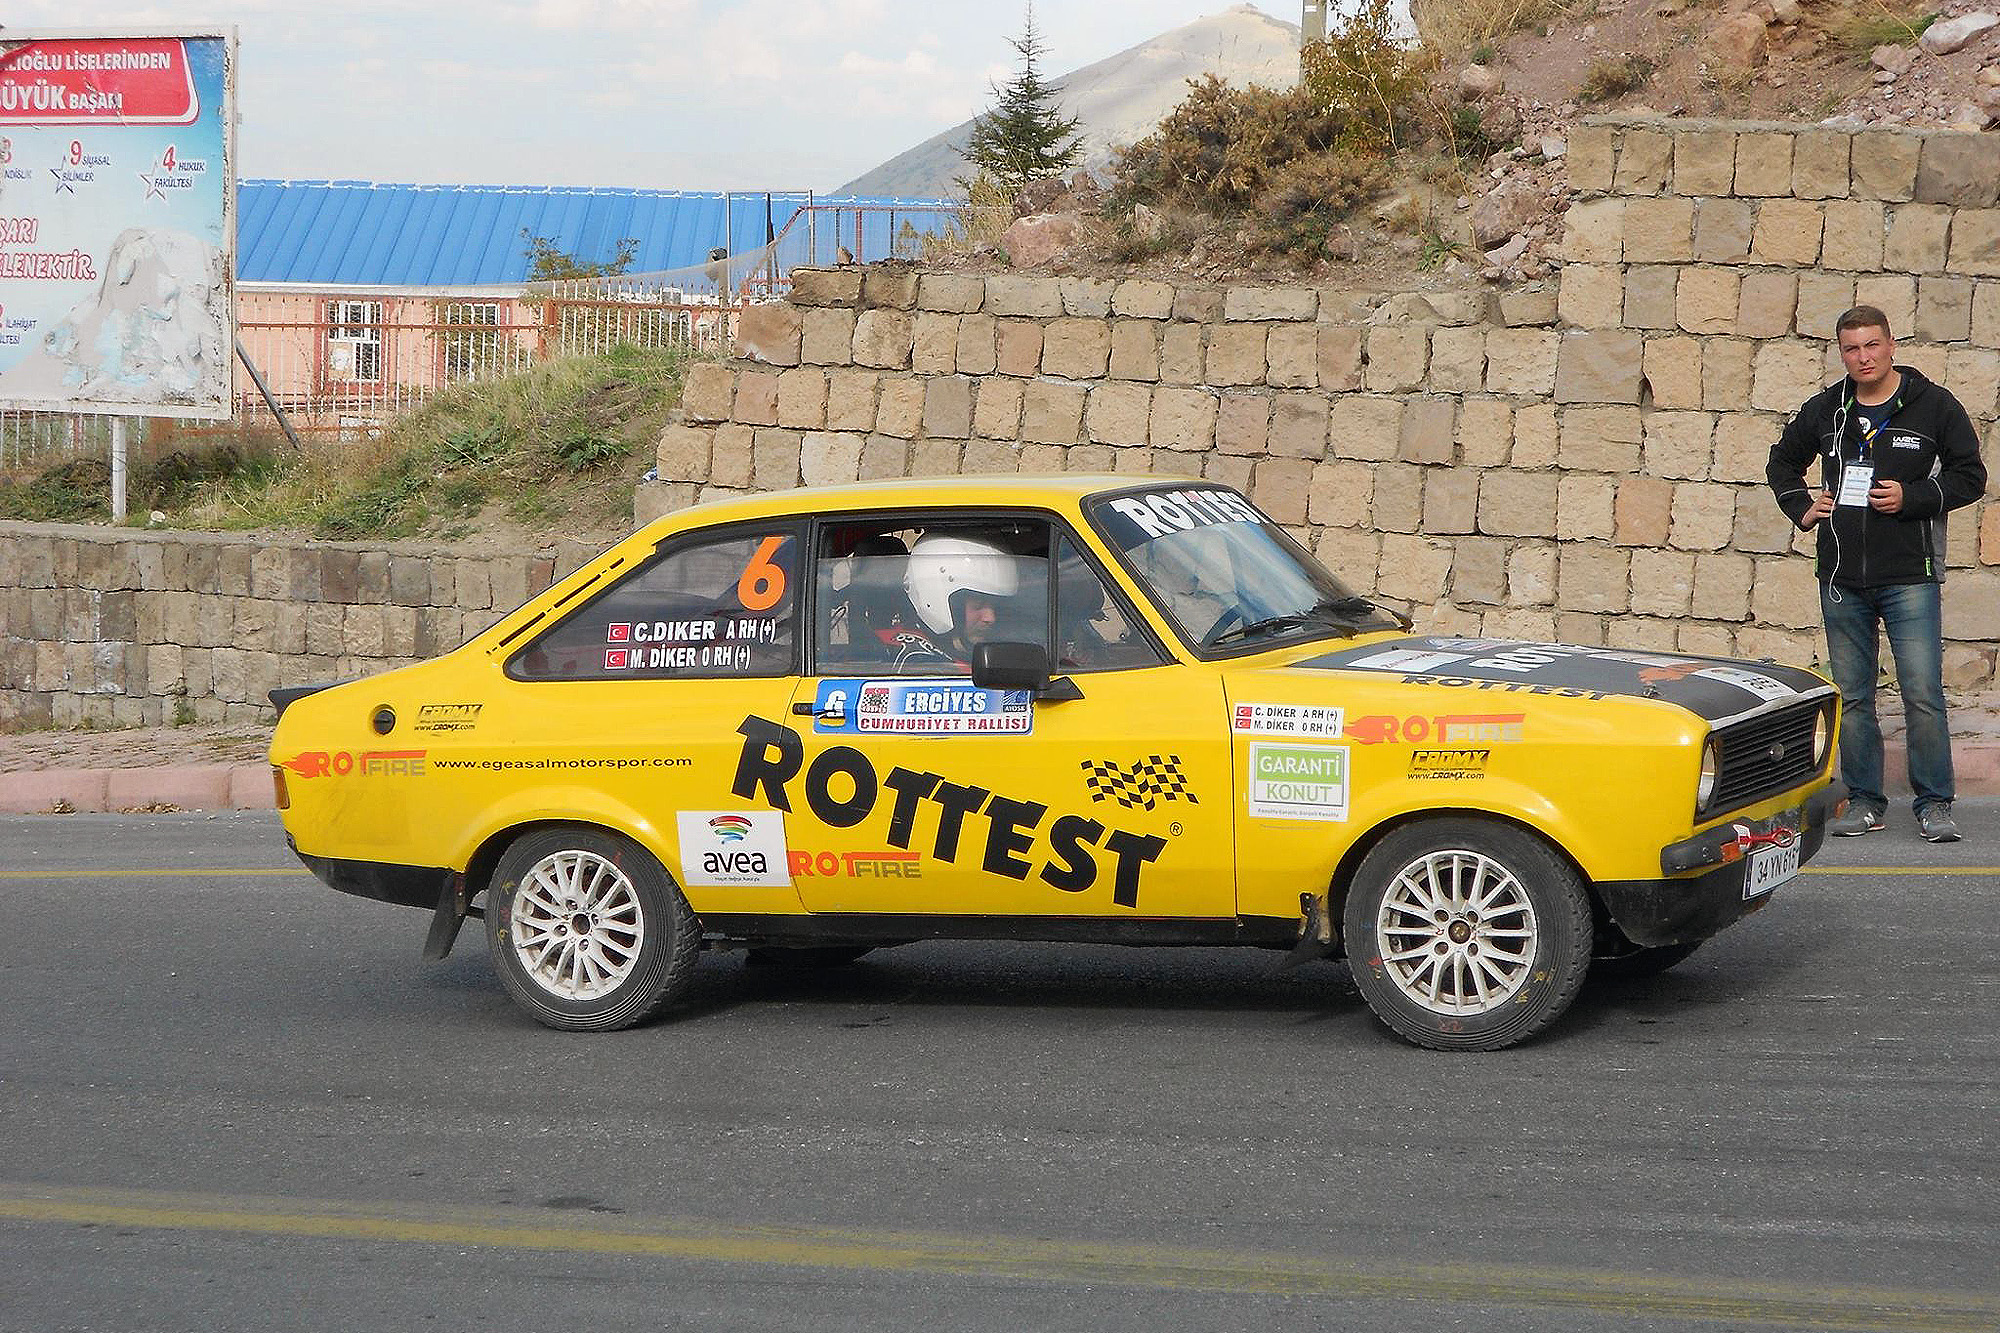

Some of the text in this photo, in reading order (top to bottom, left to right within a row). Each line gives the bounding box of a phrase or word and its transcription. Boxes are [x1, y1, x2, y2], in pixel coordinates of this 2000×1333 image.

[65, 49, 171, 71] LİSELERİNDEN
[70, 141, 82, 166] 9
[162, 146, 206, 172] 4 HUKUK
[154, 177, 193, 188] FAKÜLTESİ
[737, 535, 787, 612] 6
[725, 619, 737, 640] A
[739, 618, 758, 640] RH
[629, 648, 646, 669] M.
[649, 646, 696, 669] DİKER
[713, 646, 732, 667] RH
[1400, 675, 1606, 701] ROTTEST
[904, 688, 988, 714] ERCİYES
[1267, 705, 1297, 718] DİKER
[1302, 709, 1309, 719] A
[1311, 710, 1324, 719] RH
[860, 715, 1028, 731] CUMHURİYET RALLİSİ
[1266, 719, 1295, 731] DİKER
[1310, 722, 1323, 732] RH
[433, 757, 693, 771] www.egeasalmotorspor.com
[1259, 755, 1341, 777] GARANTİ
[1266, 783, 1332, 803] KONUT
[731, 714, 1169, 909] ROTTEST
[703, 851, 768, 874] avea
[1757, 859, 1769, 883] 34
